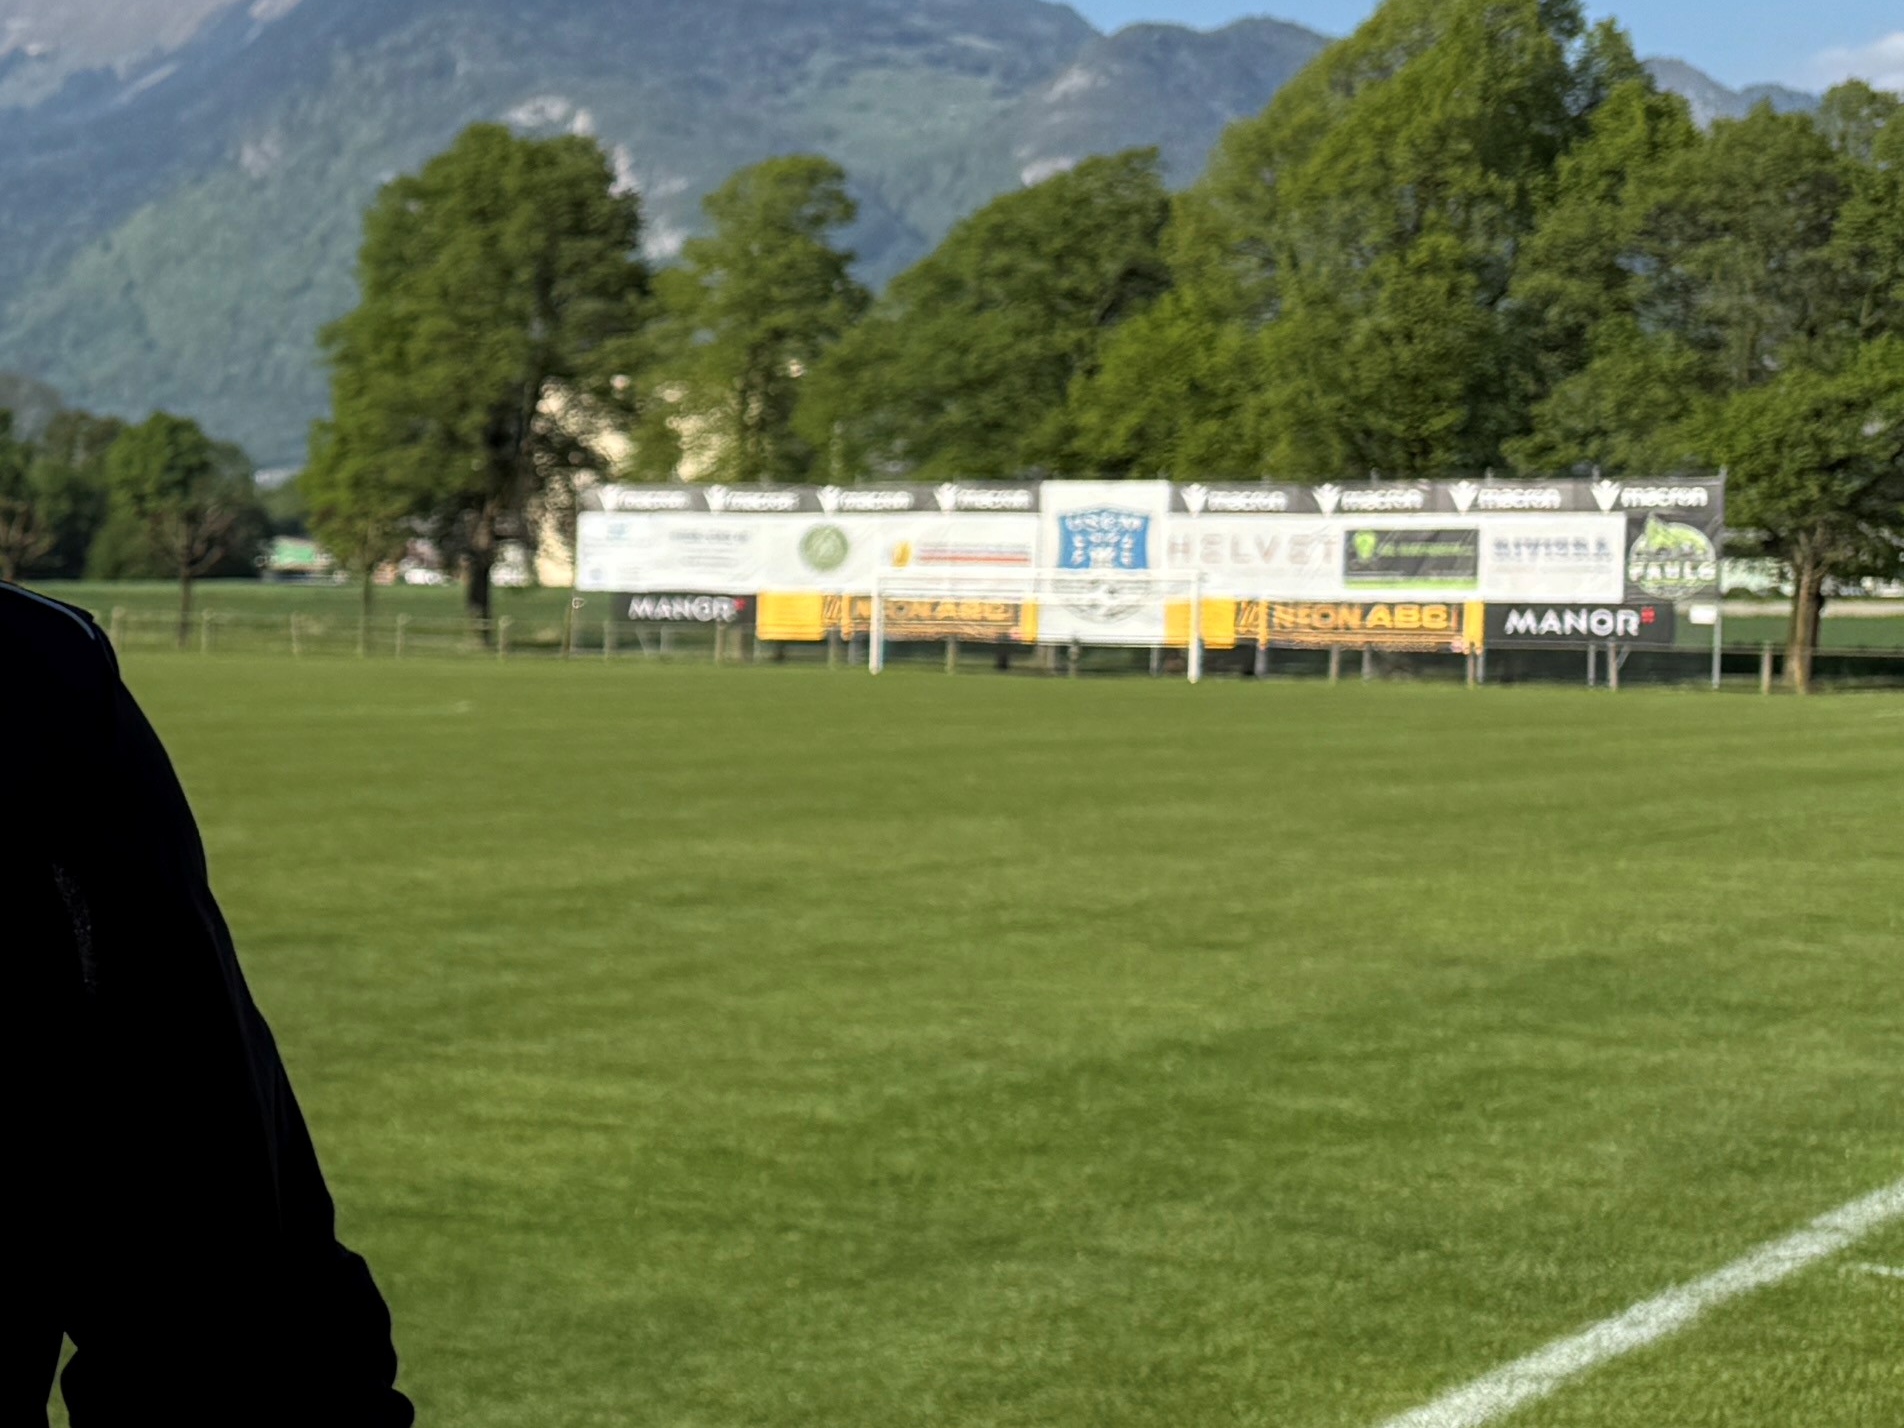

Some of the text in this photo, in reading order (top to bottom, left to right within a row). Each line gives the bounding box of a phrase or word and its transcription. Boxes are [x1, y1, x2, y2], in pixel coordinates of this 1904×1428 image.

[1477, 488, 1562, 509] macron
[1621, 487, 1708, 508] macron
[628, 596, 738, 622] MANOR
[1504, 608, 1640, 637] MANOR
